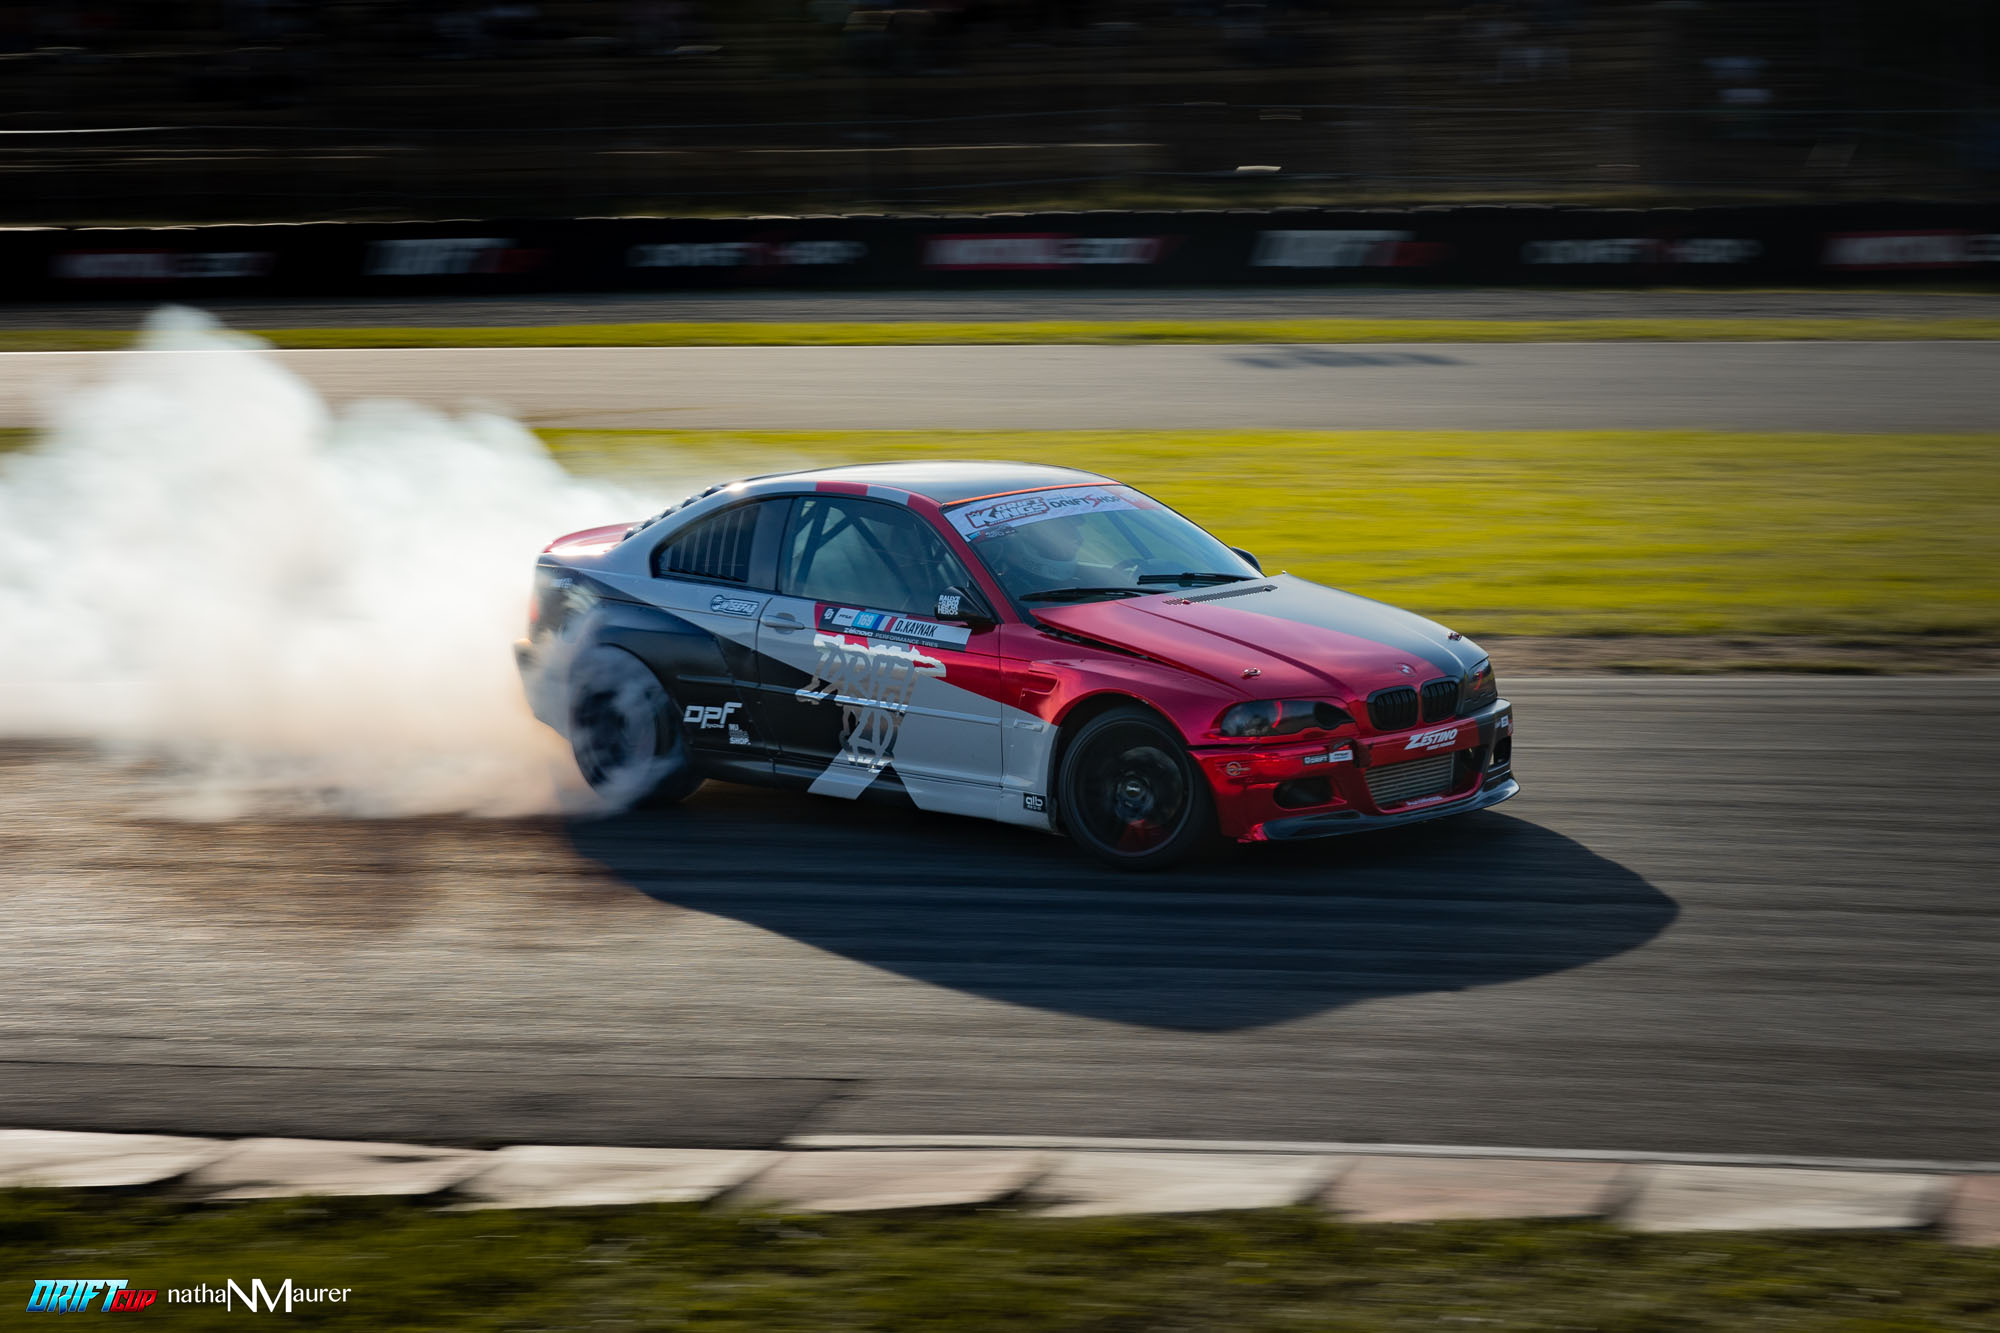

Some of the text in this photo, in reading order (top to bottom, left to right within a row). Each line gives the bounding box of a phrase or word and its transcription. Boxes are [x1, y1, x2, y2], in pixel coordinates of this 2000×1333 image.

[968, 503, 1047, 527] KINGS
[857, 613, 875, 626] 169
[894, 619, 938, 637] D.KAYNAK
[875, 632, 921, 645] PERFORMANCE
[921, 640, 938, 648] TIRES
[1404, 727, 1458, 750] ZESTINO
